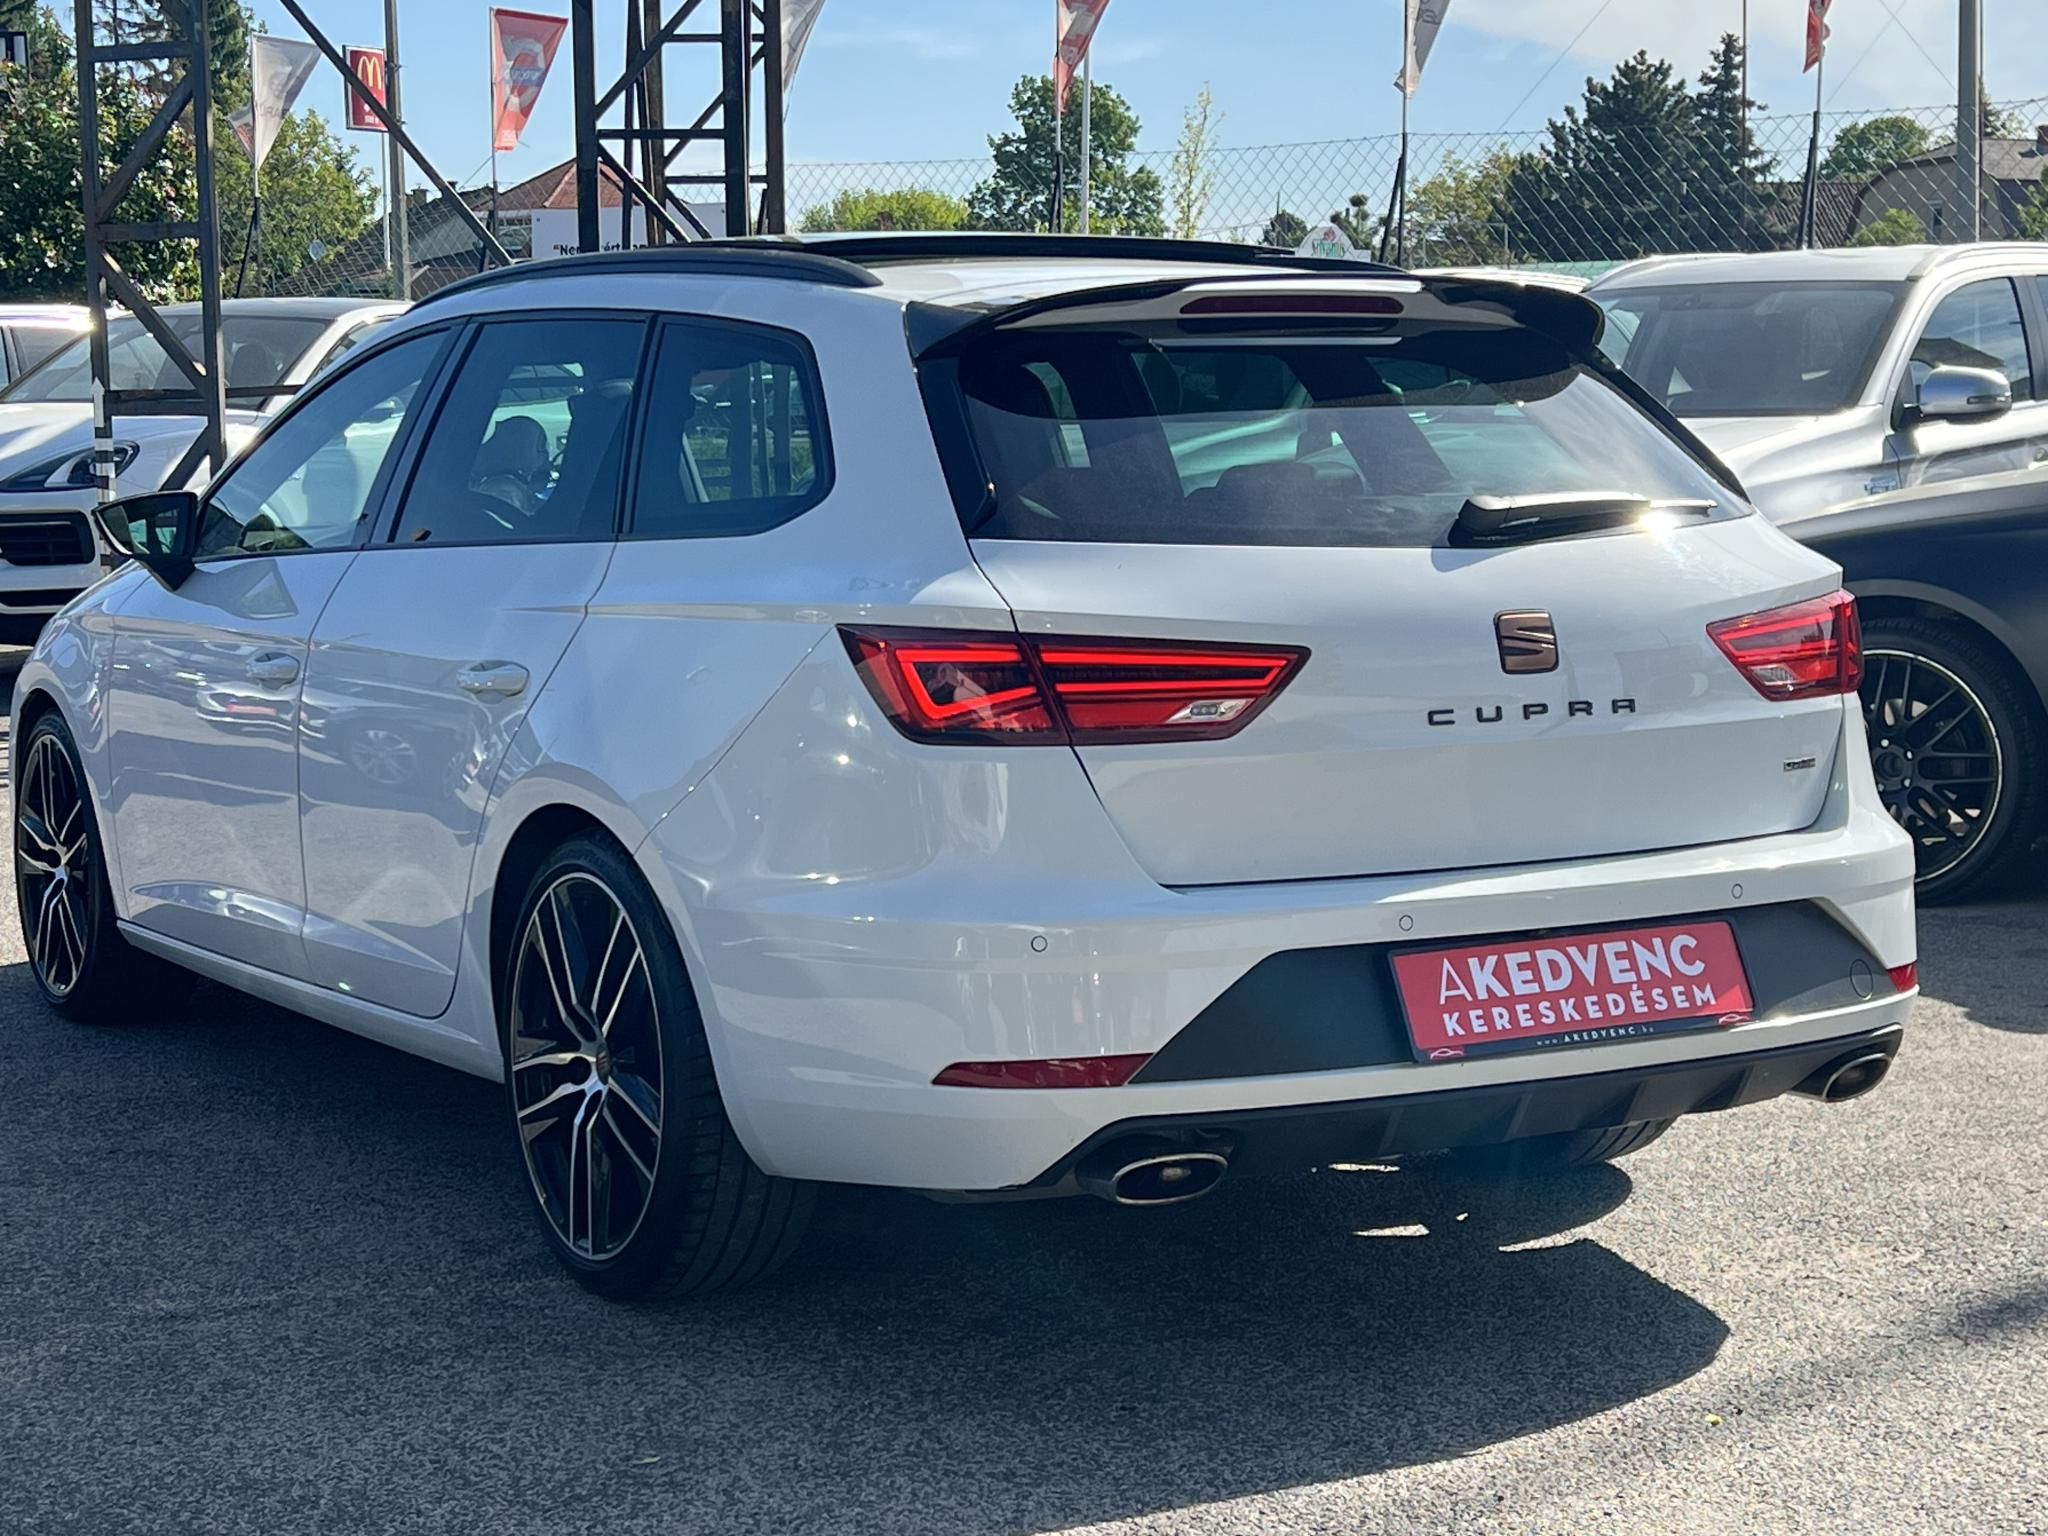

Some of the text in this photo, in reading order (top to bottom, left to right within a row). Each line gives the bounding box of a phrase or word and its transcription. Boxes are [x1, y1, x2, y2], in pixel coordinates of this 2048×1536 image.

[1427, 698, 1637, 727] CUPRA
[1439, 933, 1706, 1006] AKEDVENC
[1442, 983, 1717, 1037] KERESKEDÉSEM
